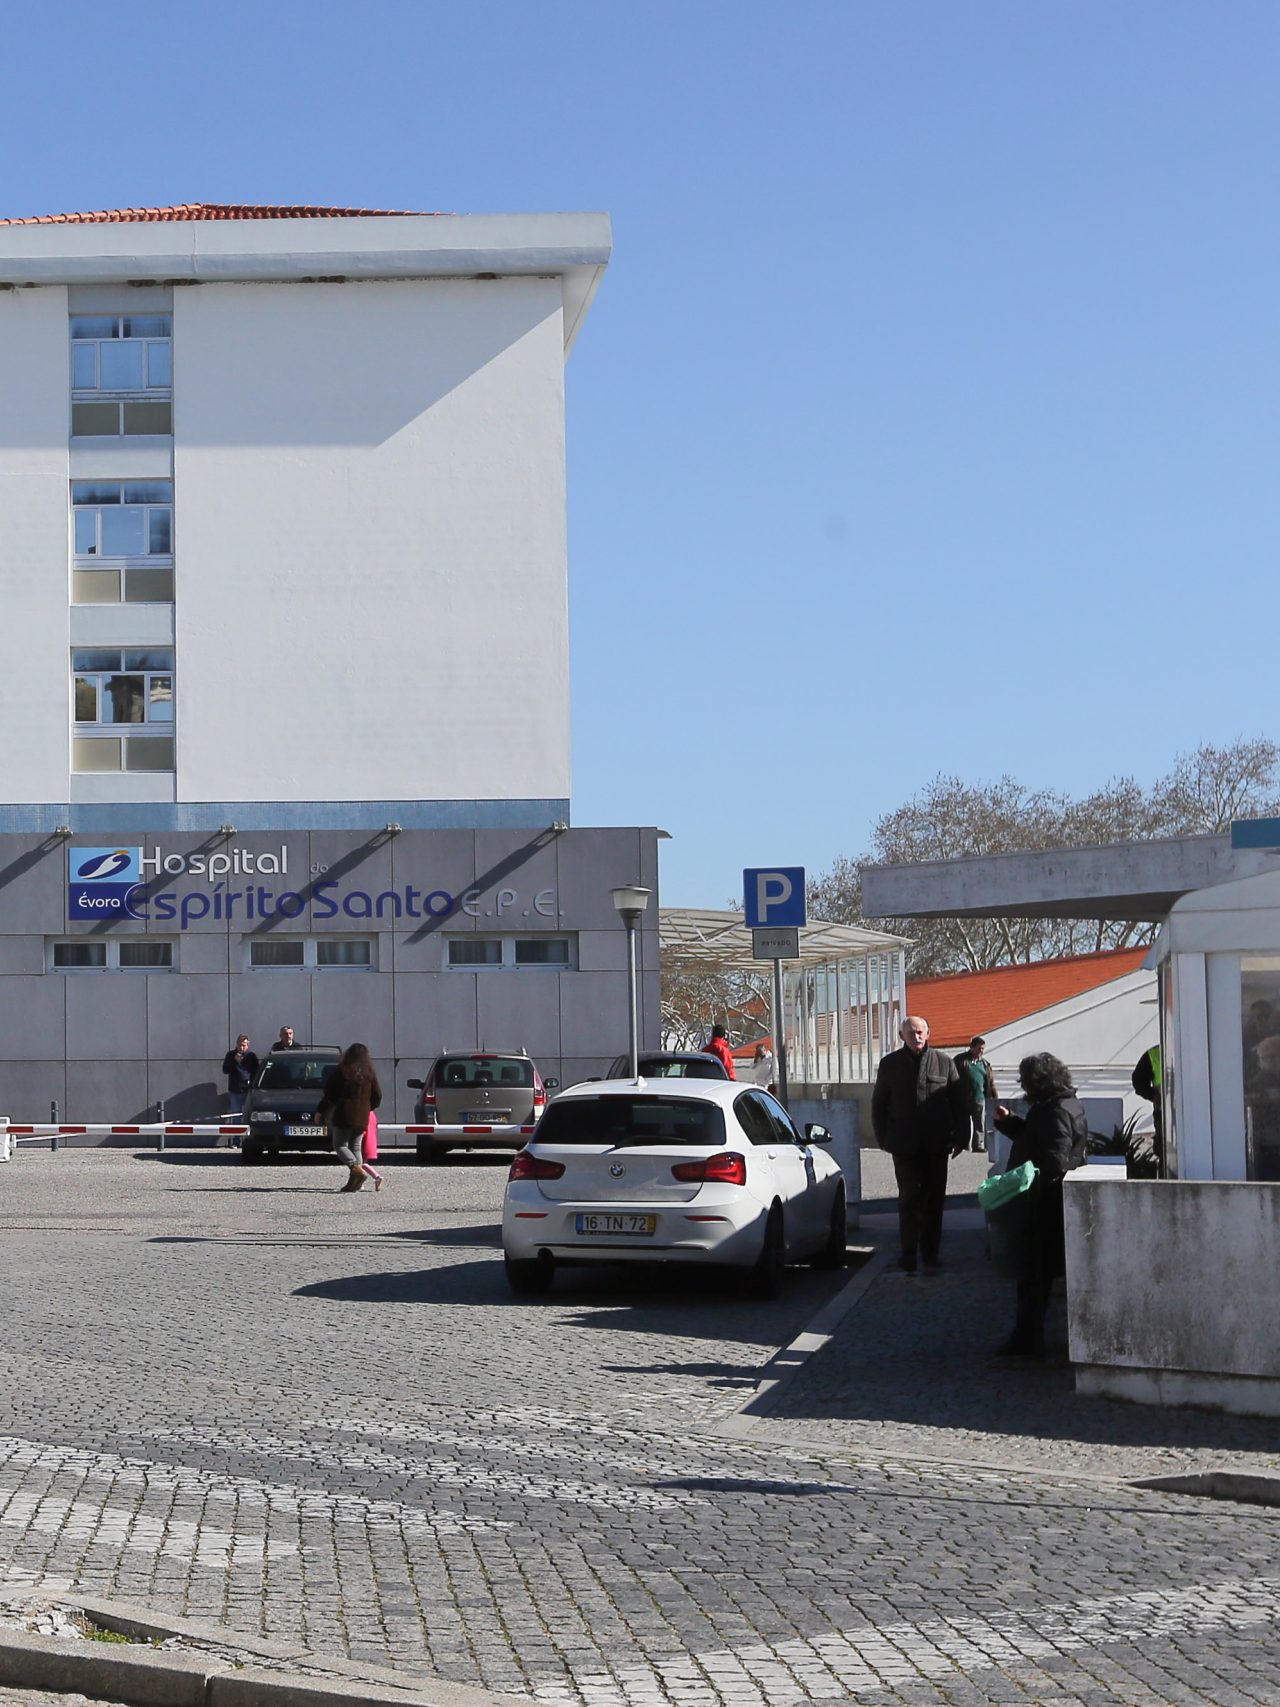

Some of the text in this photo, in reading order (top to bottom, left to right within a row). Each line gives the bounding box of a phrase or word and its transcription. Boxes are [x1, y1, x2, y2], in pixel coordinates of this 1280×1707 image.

[138, 845, 329, 882] Hospital do
[78, 891, 121, 908] Évora
[124, 881, 306, 930] Espírito
[312, 881, 455, 919] Santo
[757, 872, 793, 923] P
